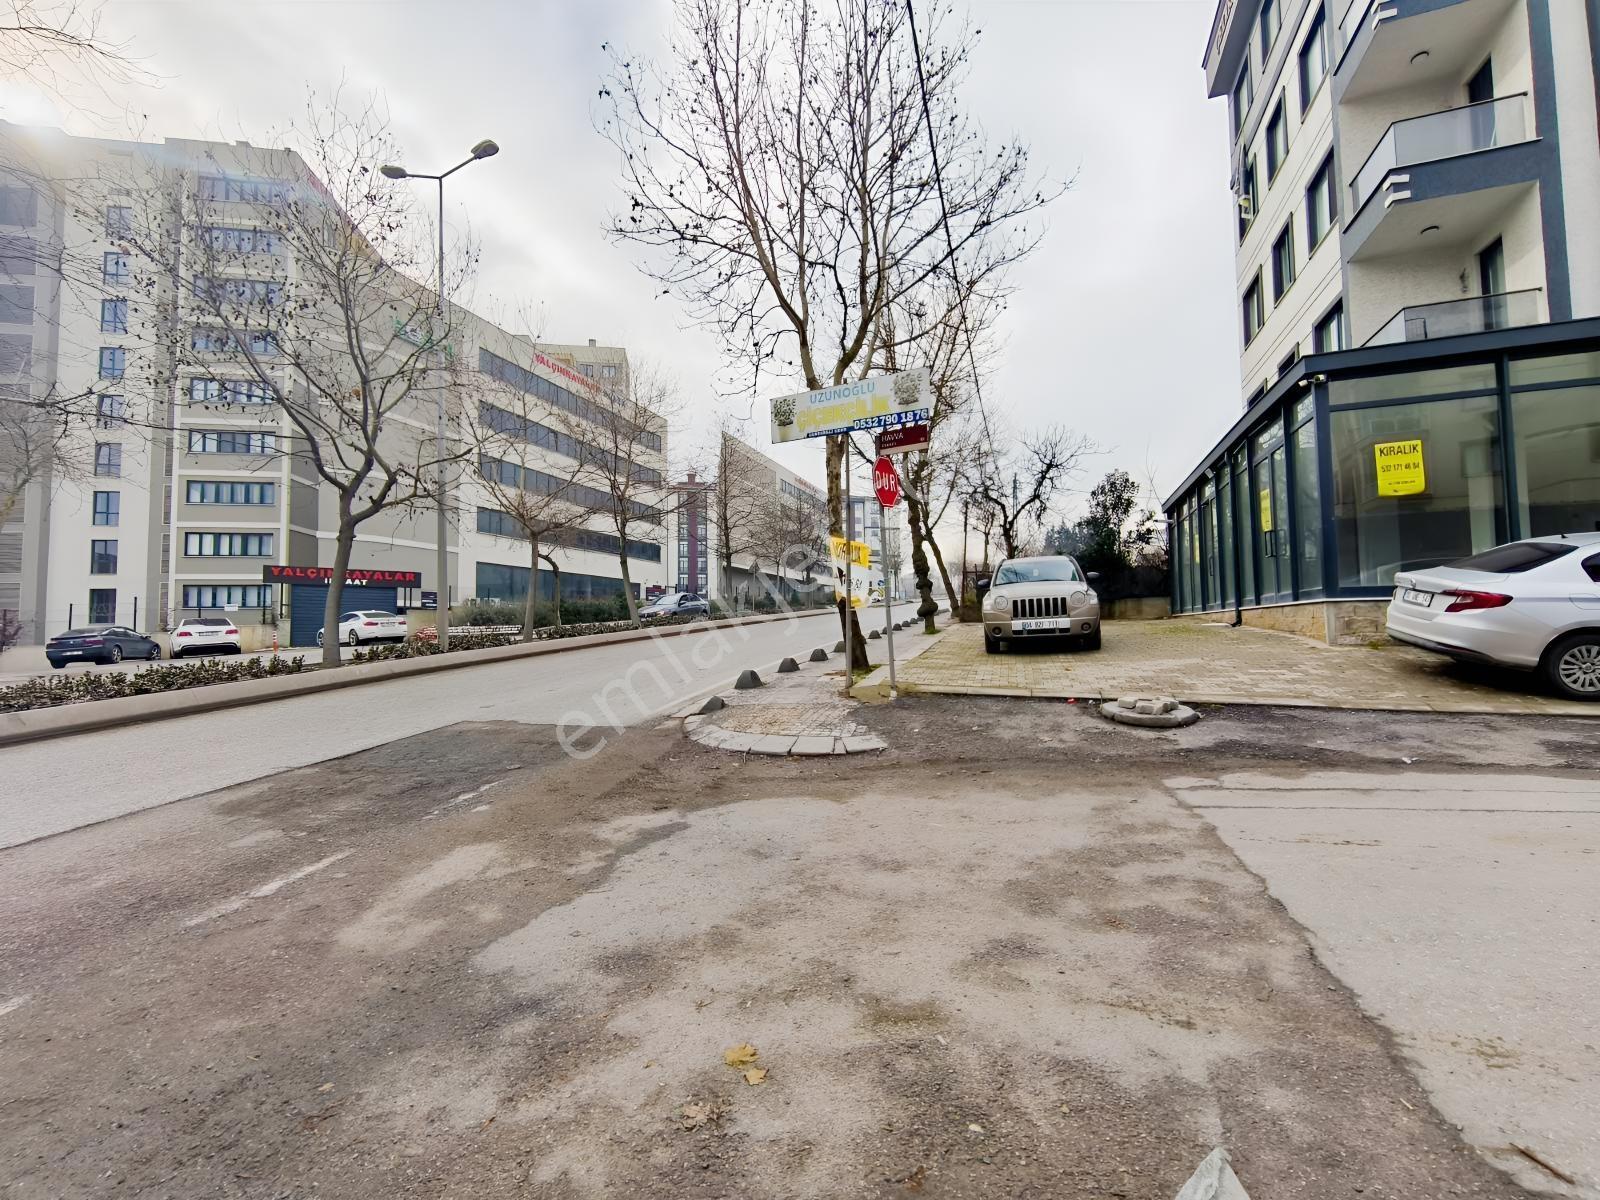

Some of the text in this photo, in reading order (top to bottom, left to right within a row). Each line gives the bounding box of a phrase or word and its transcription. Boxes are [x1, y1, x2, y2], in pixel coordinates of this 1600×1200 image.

[810, 382, 875, 404] UZUNOĞLU
[854, 408, 928, 430] 0532 790 18 76
[1379, 444, 1419, 457] KIRALIK
[875, 470, 897, 492] DUR
